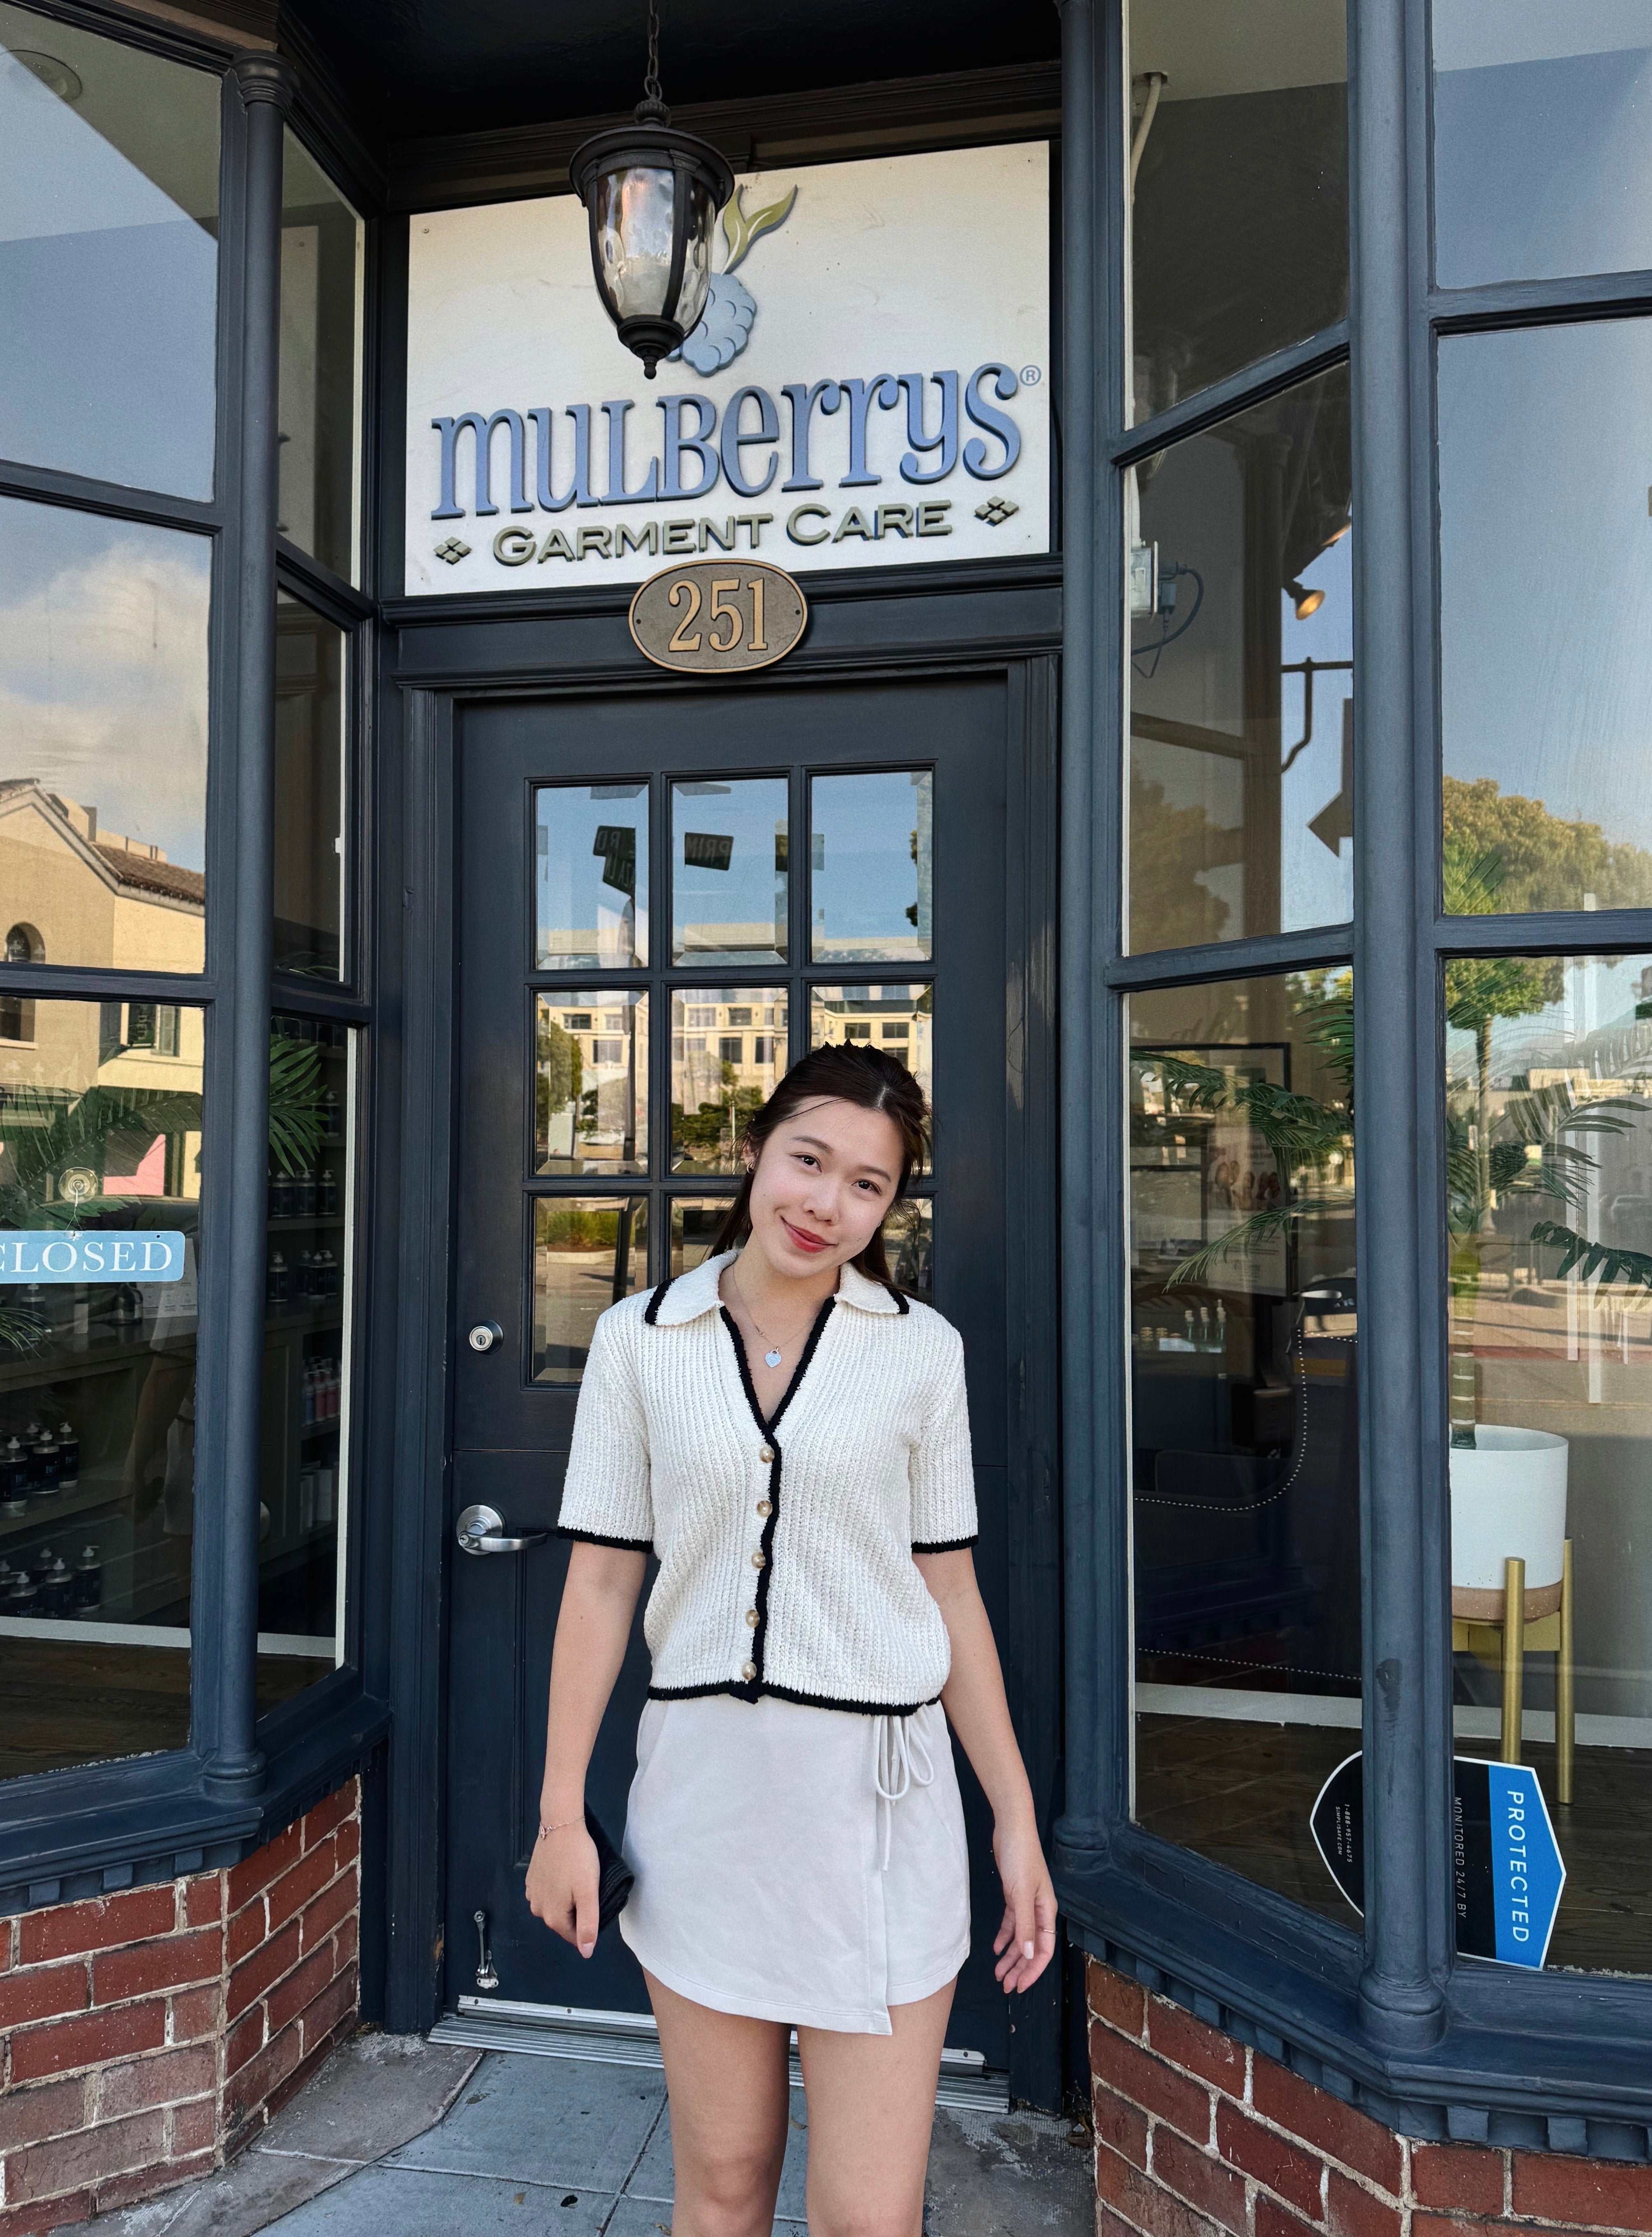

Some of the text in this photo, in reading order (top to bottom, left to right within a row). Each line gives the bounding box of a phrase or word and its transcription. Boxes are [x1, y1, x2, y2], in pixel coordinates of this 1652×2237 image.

[493, 500, 952, 566] GARMENT CARE
[669, 577, 768, 652] 251
[0, 1242, 172, 1272] LOSED
[1454, 1797, 1466, 1918] MONITORED 24/7 BY
[1507, 1790, 1529, 1942] PROTECTED
